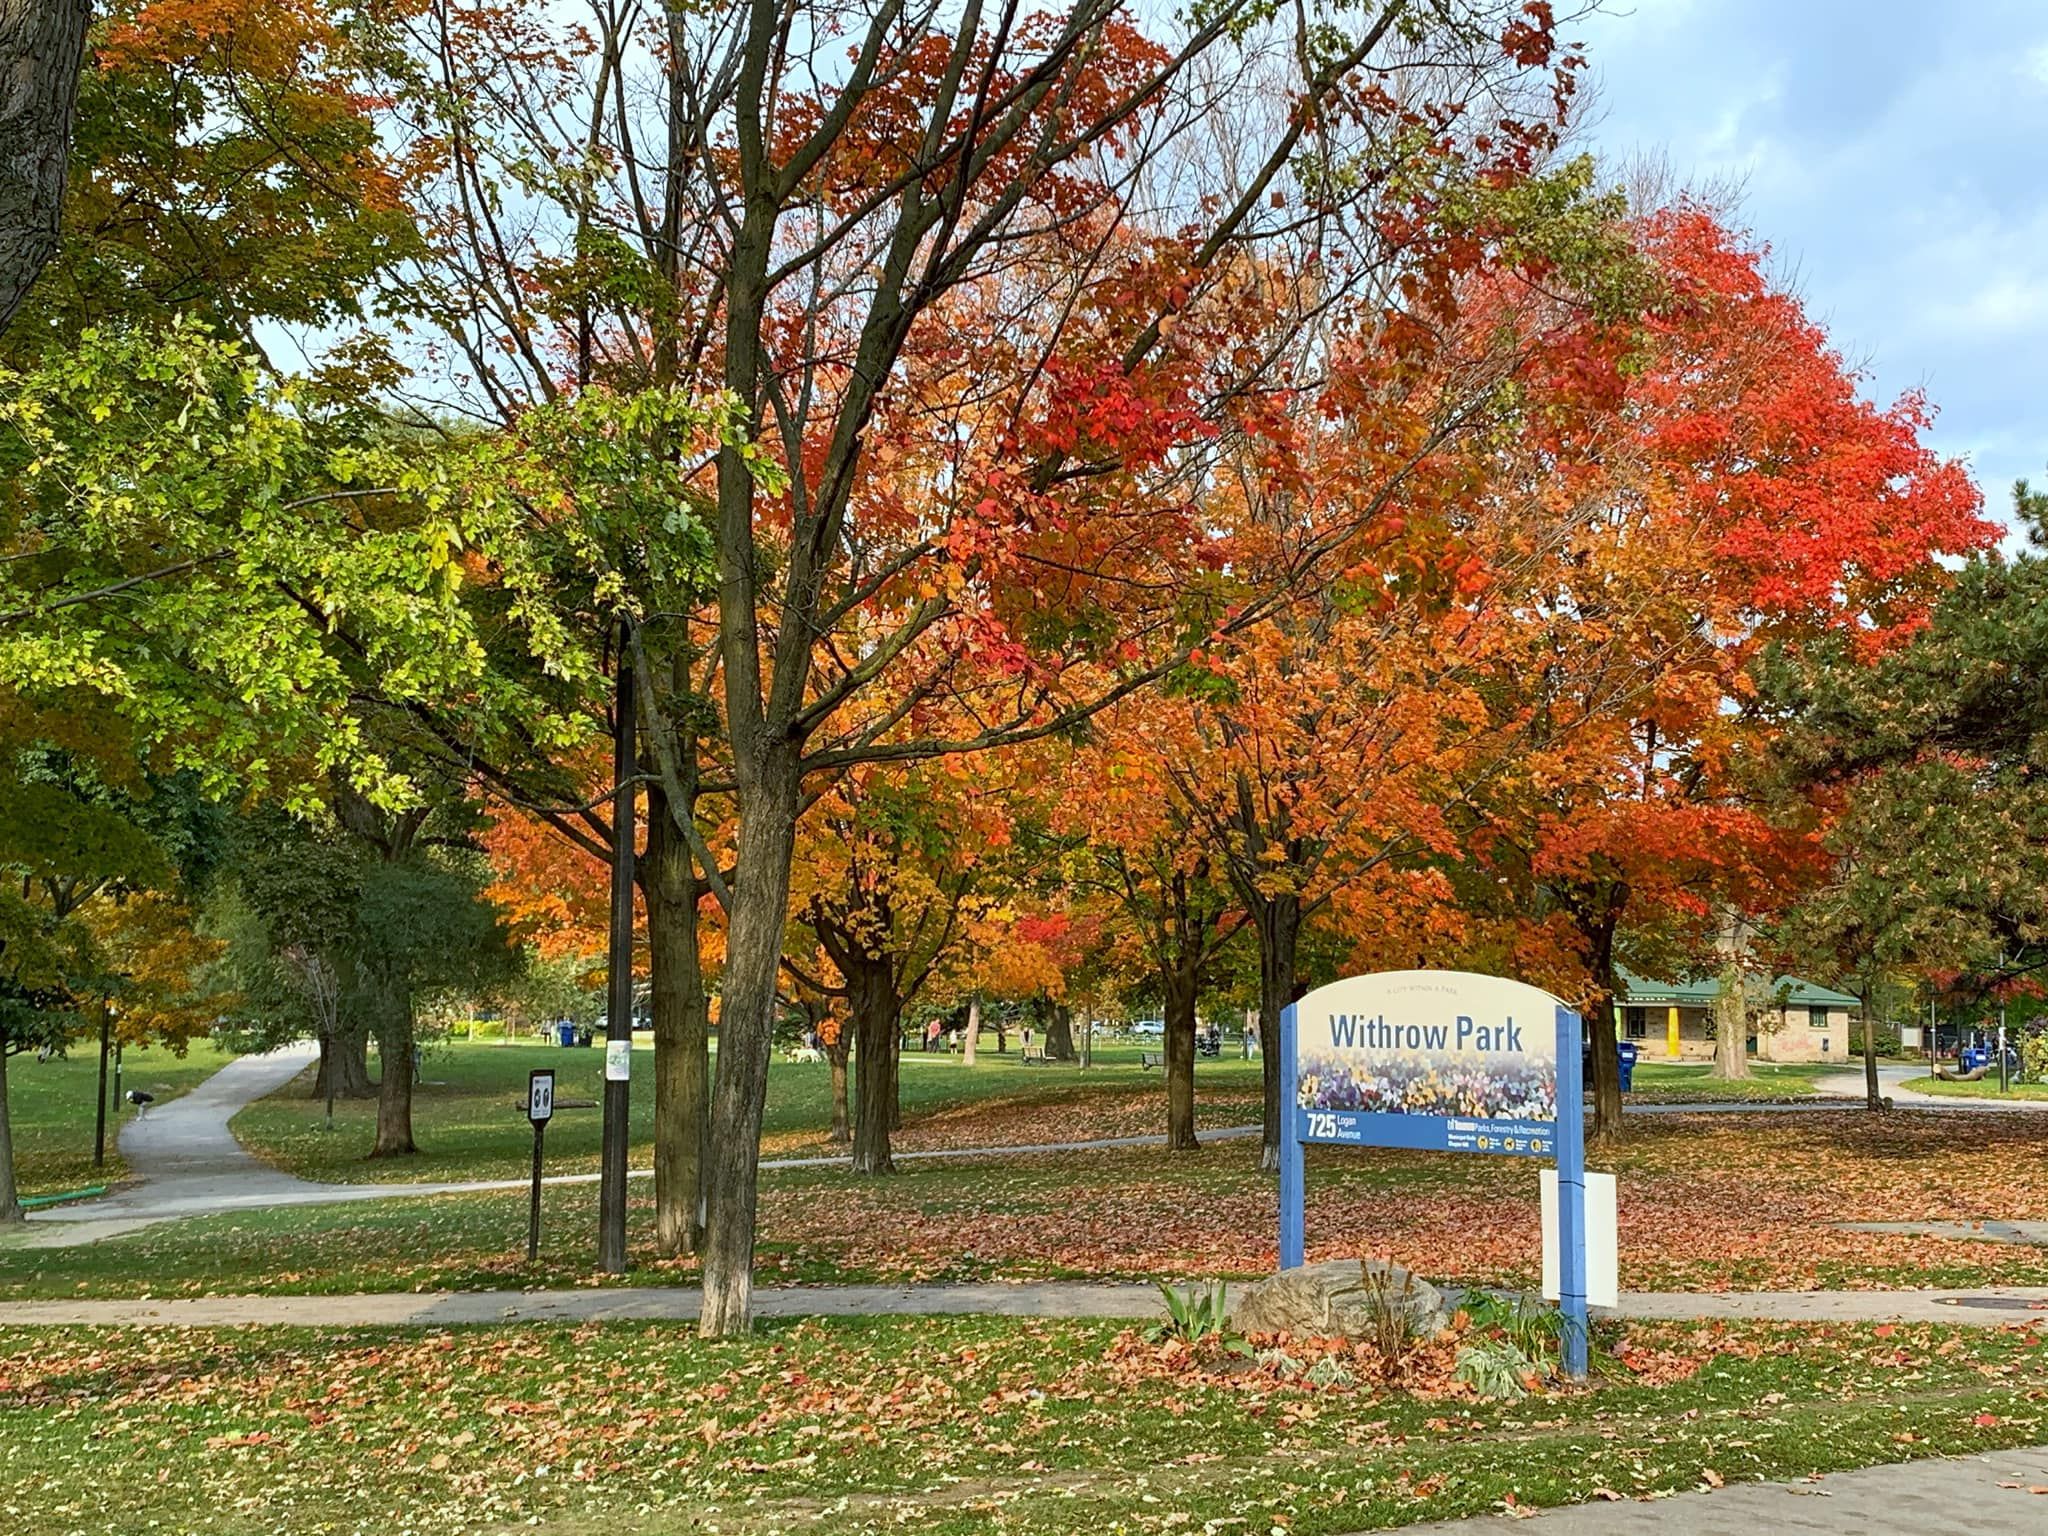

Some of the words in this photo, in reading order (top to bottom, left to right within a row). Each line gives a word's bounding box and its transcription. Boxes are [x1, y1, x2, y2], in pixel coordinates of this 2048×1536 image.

[1329, 1014, 1448, 1050] Withrow
[1456, 1015, 1523, 1052] Park
[1307, 1113, 1336, 1138] 725
[1337, 1115, 1357, 1127] Logan
[1337, 1128, 1361, 1140] Avenue
